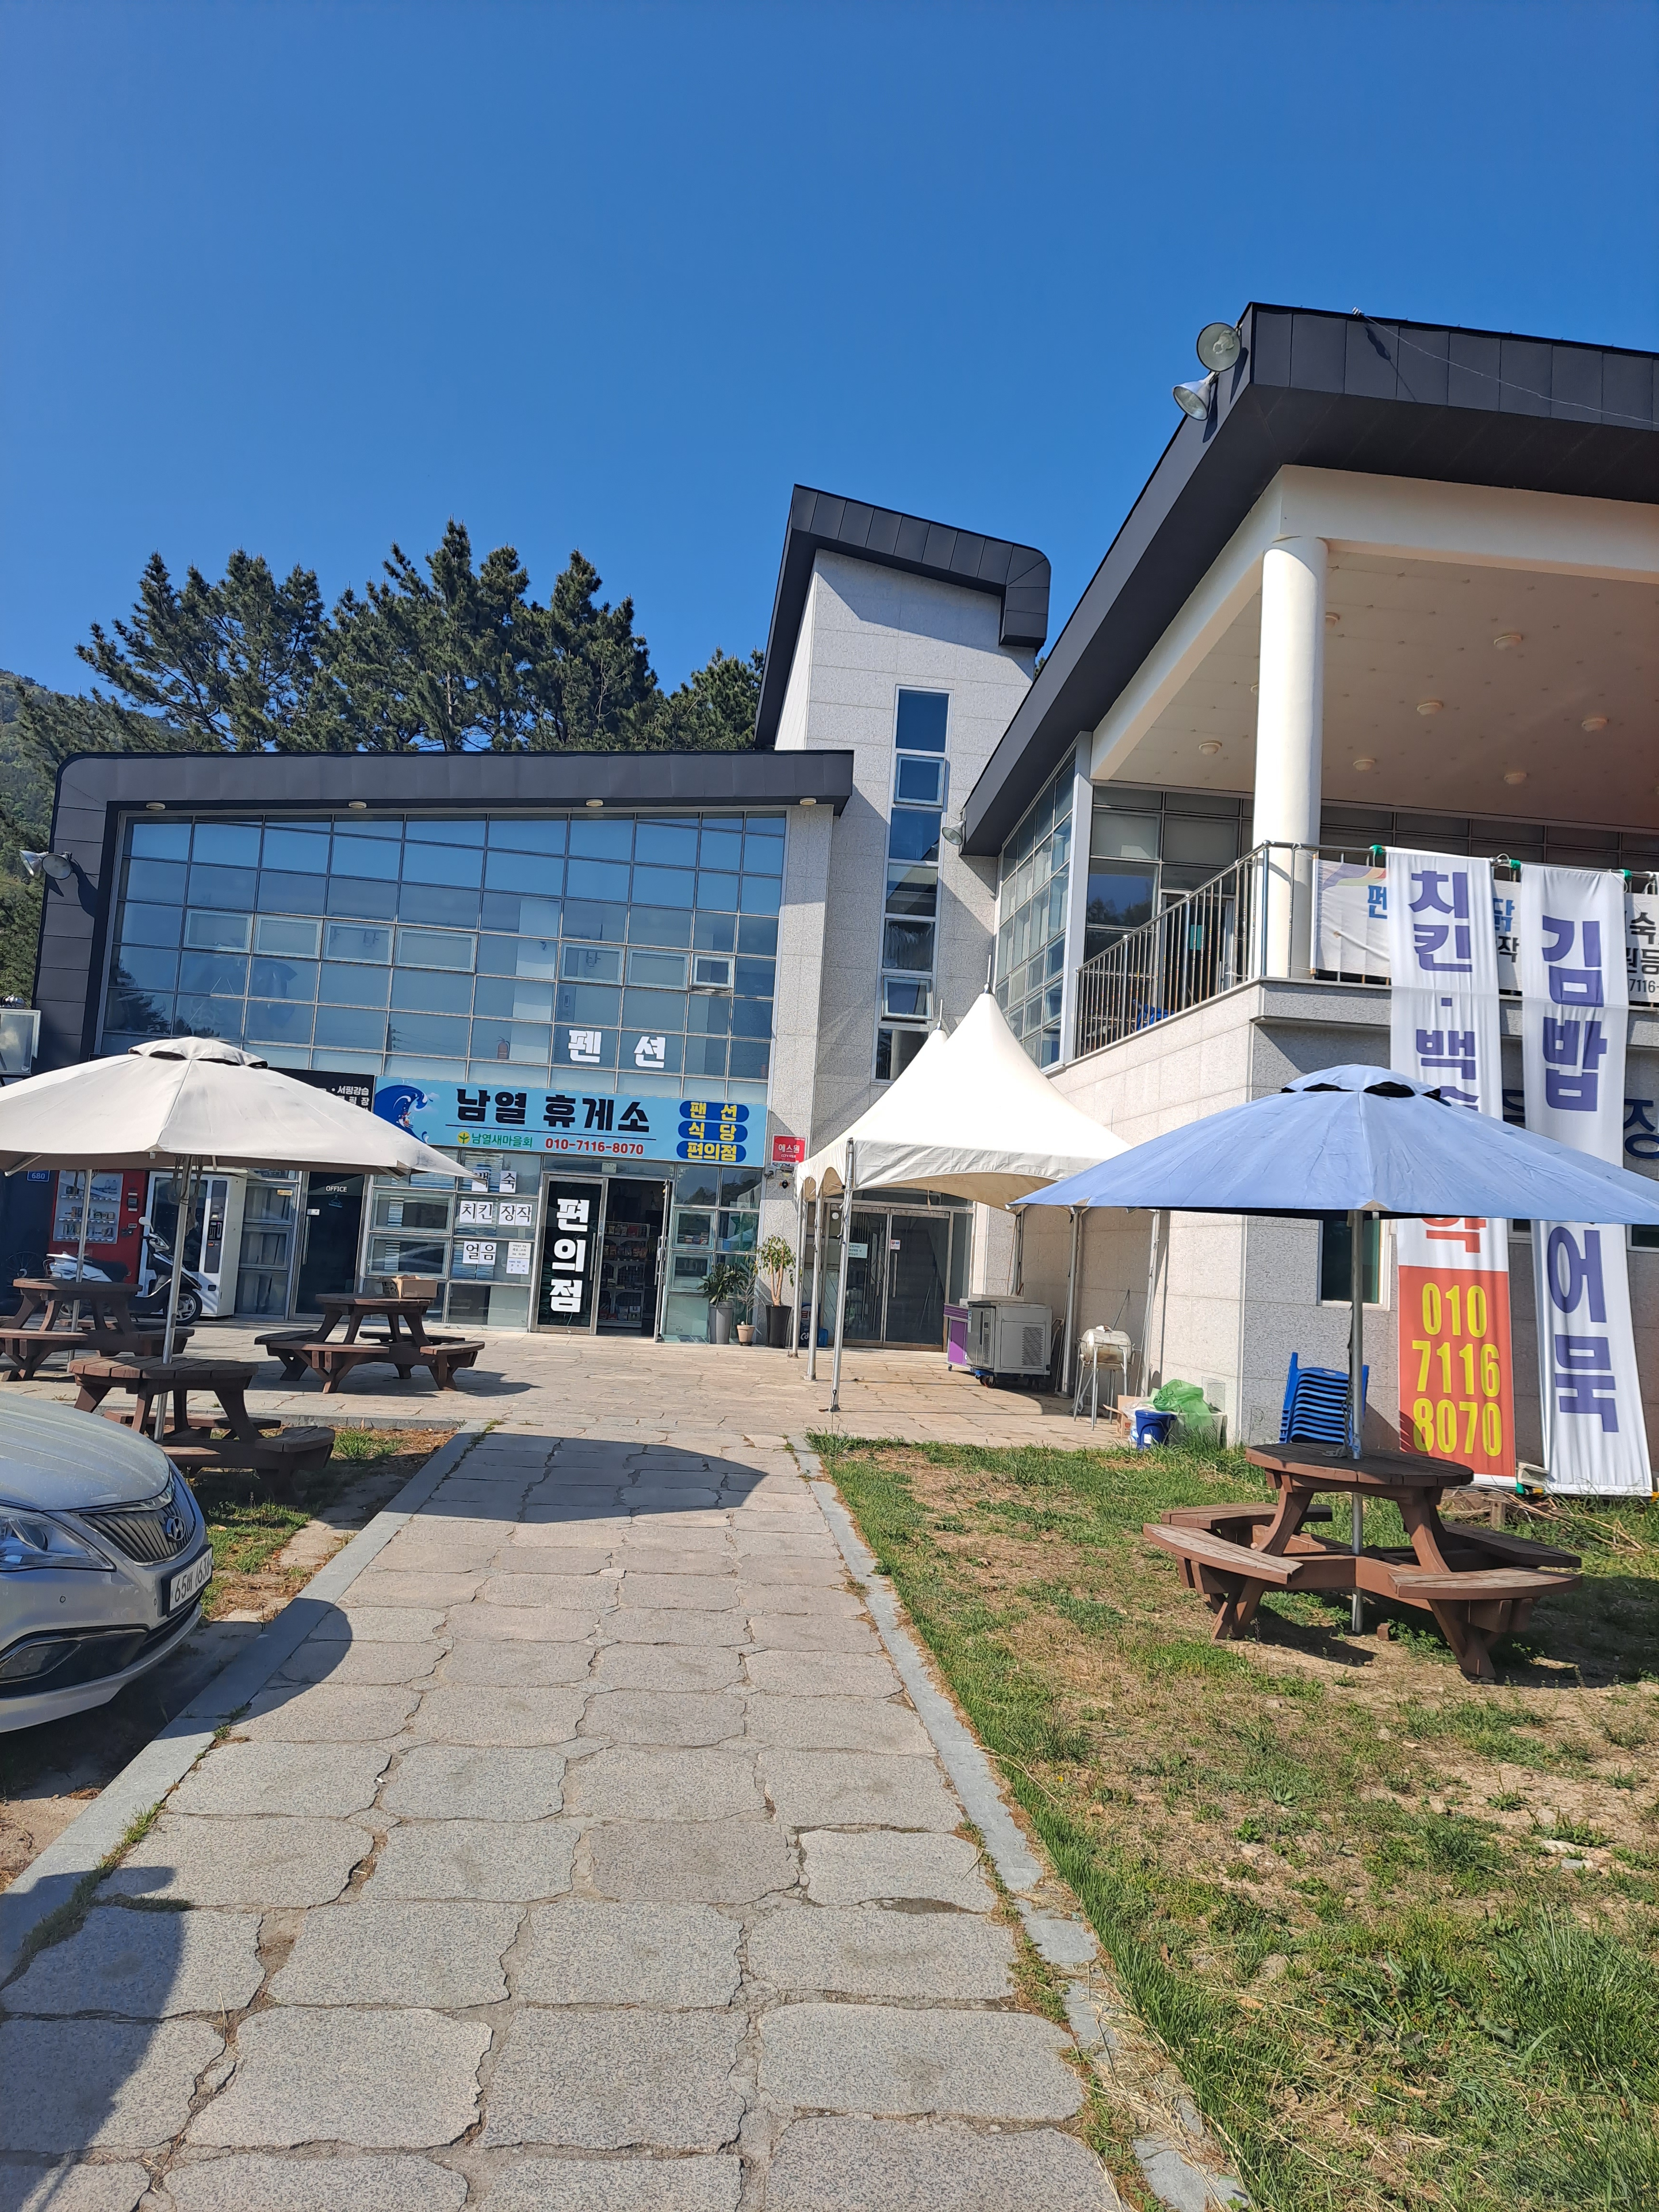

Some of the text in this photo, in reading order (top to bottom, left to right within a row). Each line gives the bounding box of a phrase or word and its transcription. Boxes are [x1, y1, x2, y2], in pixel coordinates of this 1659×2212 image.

[456, 1088, 650, 1133] 남열 휴게소
[472, 1133, 533, 1148] 남열새마을회
[545, 1138, 644, 1155] 010-7116-8070
[687, 1142, 737, 1161] 편의점
[778, 1144, 800, 1153] 에스원
[1542, 915, 1619, 1433] 김밥 어묵
[461, 1203, 531, 1222] 치킨 장작
[466, 1244, 496, 1260] 얼음
[549, 1198, 590, 1313] 편의점
[1421, 1282, 1487, 1338] 010
[1412, 1340, 1500, 1397] 7116
[1413, 1398, 1502, 1457] 8070
